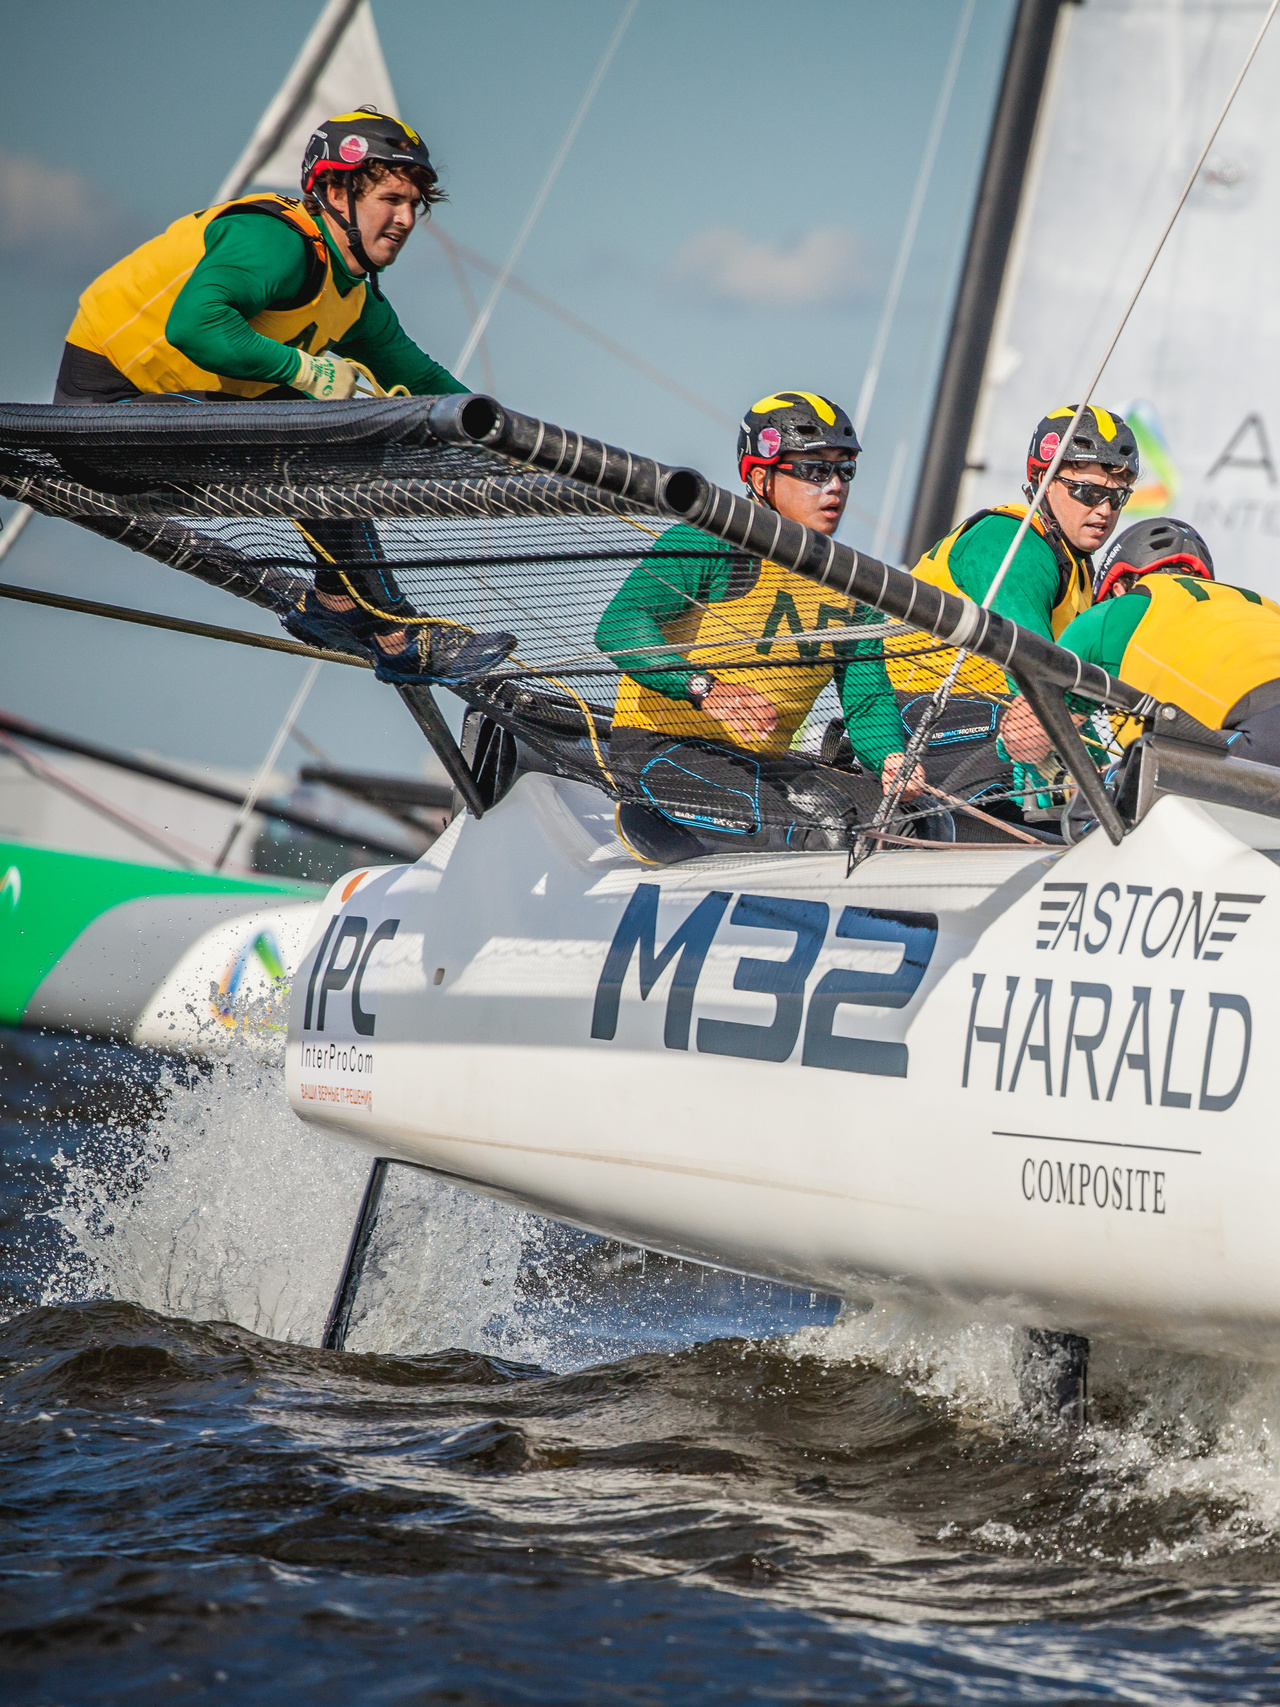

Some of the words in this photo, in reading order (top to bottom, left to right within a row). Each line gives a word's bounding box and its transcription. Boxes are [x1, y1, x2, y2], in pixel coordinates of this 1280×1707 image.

[1103, 543, 1122, 570] NEGRI
[1036, 882, 1266, 961] ASTON
[303, 914, 401, 1037] IPC
[590, 882, 939, 1079] M32
[301, 1041, 373, 1074] InterProCom
[961, 973, 1252, 1112] HARALD
[1022, 1158, 1166, 1214] COMPOSITE
